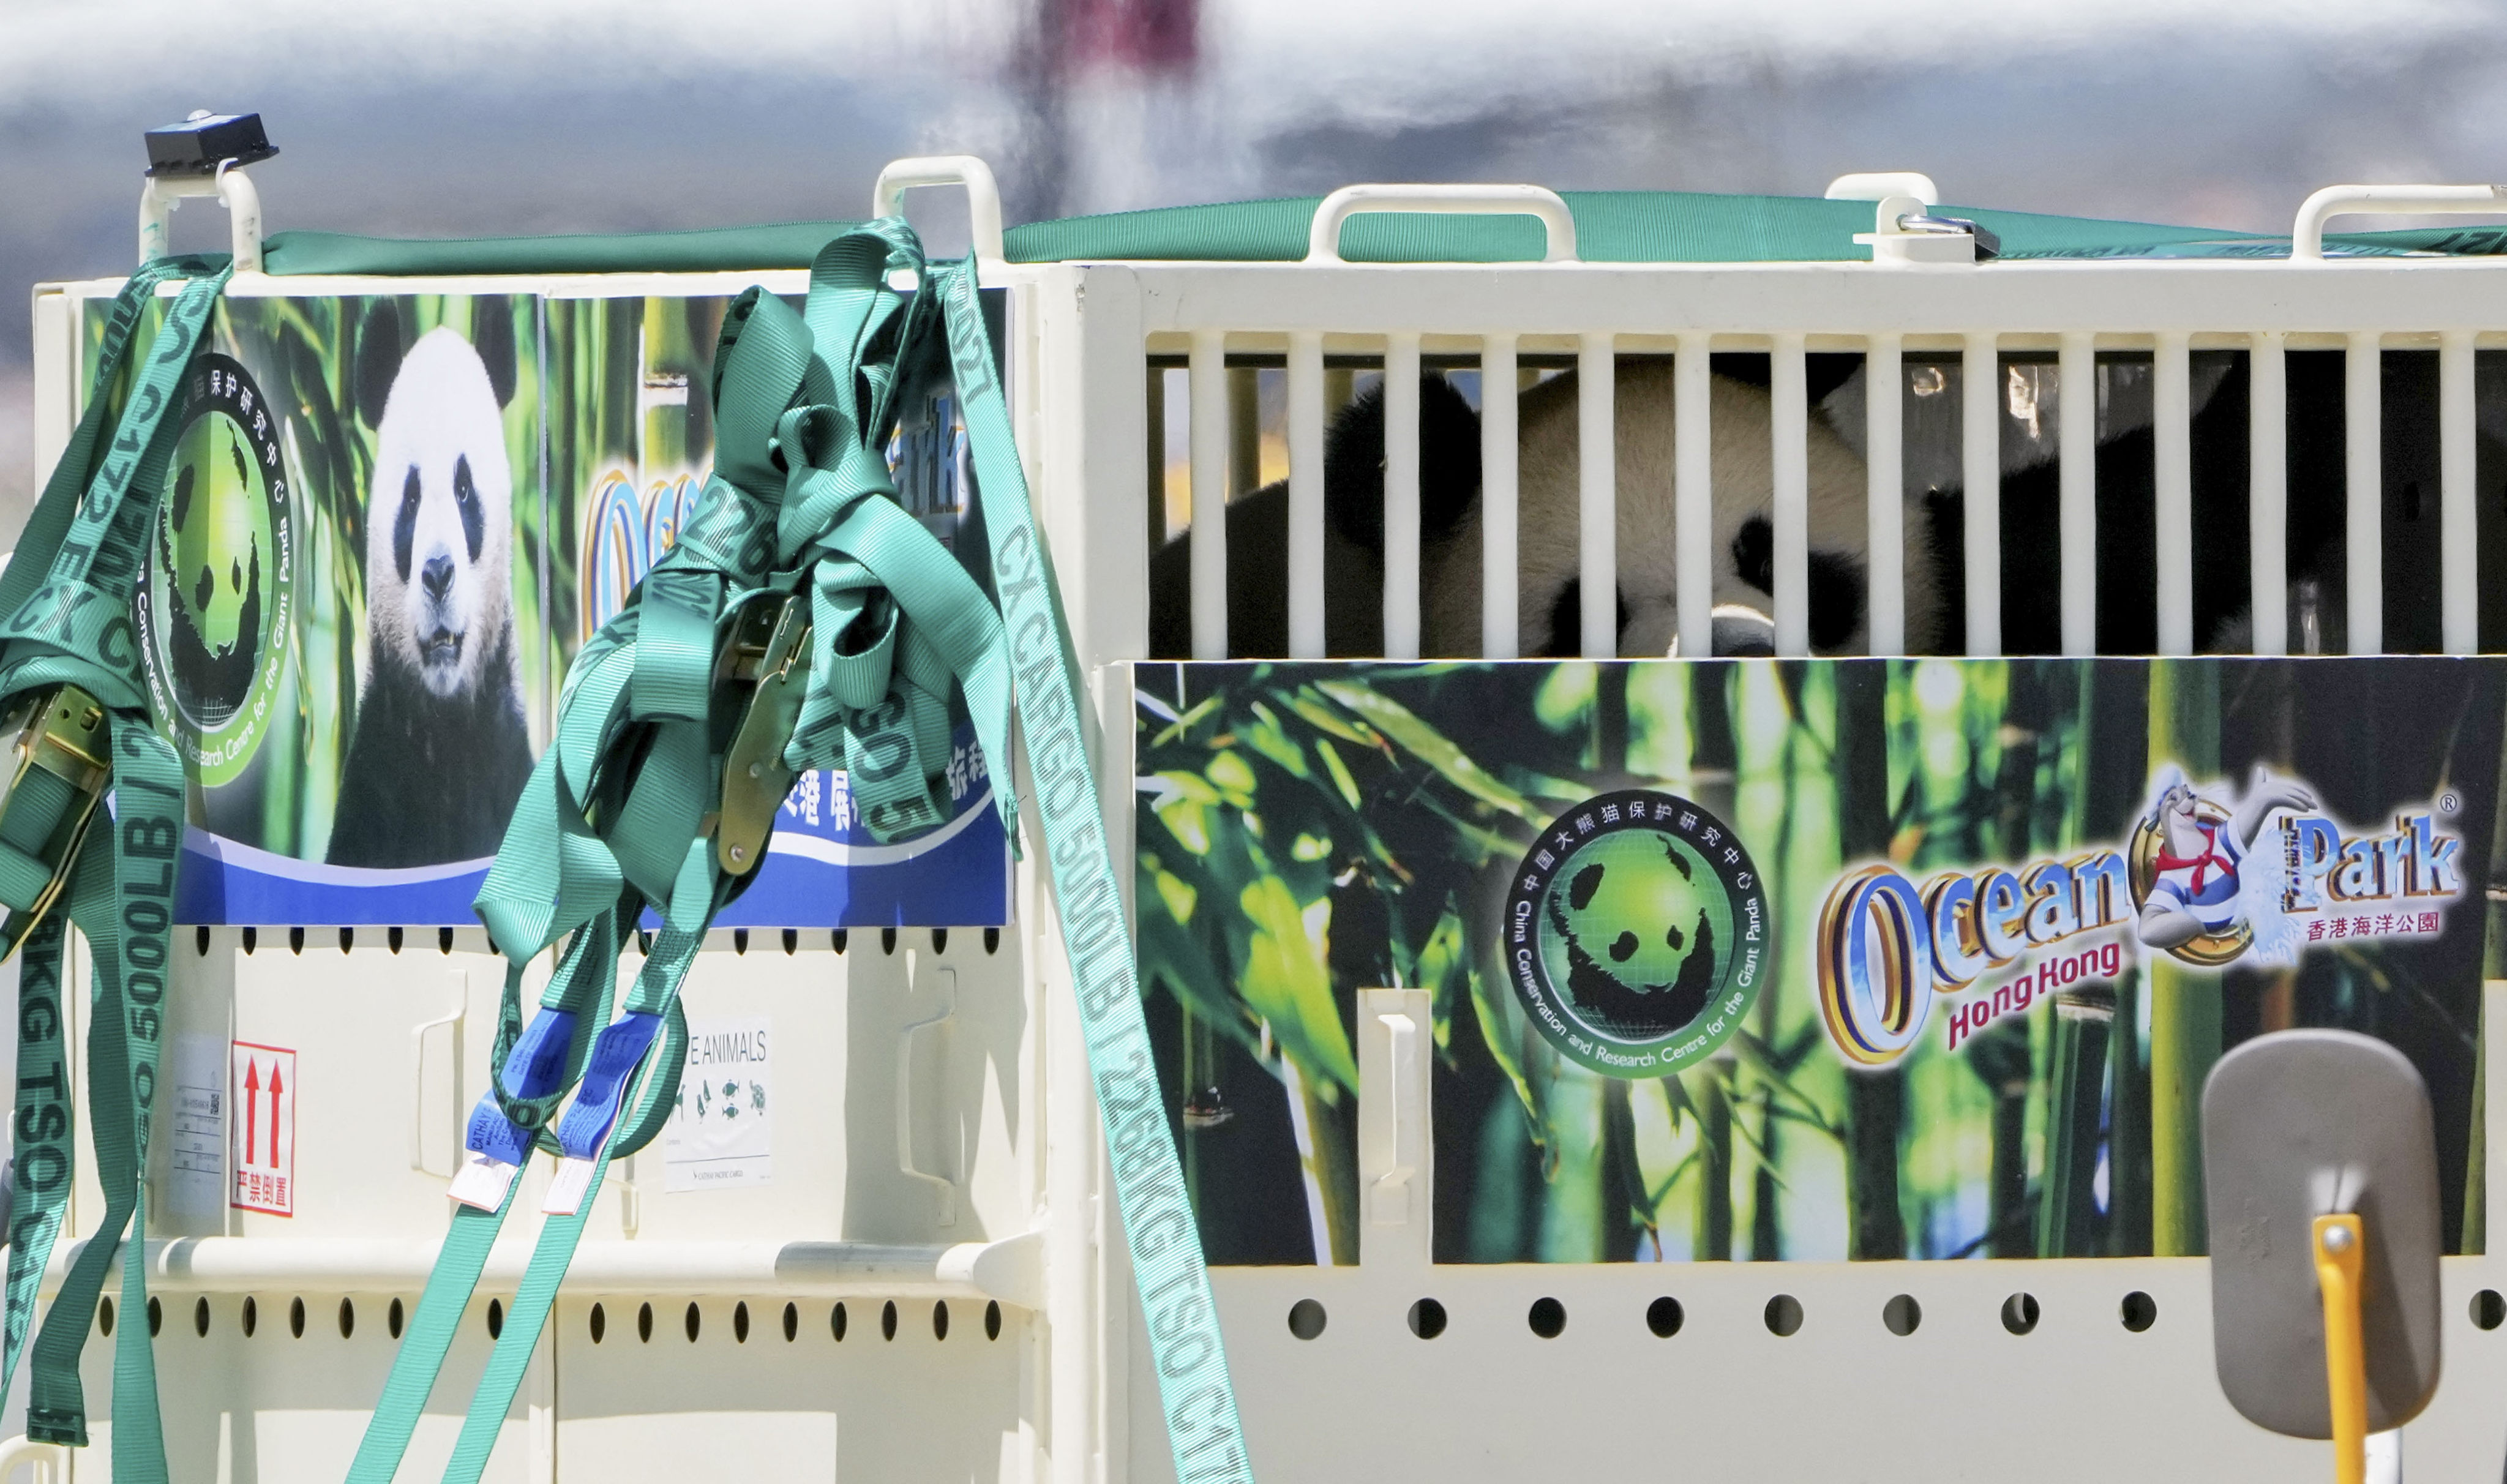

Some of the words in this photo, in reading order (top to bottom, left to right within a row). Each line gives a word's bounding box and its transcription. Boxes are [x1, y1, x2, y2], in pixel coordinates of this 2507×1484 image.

[280, 516, 289, 582] Panda
[997, 525, 1038, 613] CX
[274, 592, 288, 649] Giant
[138, 592, 168, 721] Conservation
[265, 657, 277, 690] the
[253, 692, 267, 722] for
[1015, 612, 1085, 820] CARGO
[168, 719, 183, 748] and
[186, 736, 223, 766] Research
[225, 721, 254, 760] Centre
[1523, 801, 1753, 893] 中国大熊猫保护研究中心
[124, 816, 177, 1043] 5000LB
[1056, 823, 1130, 1022] 5000LB
[1513, 900, 1532, 943] China
[1744, 897, 1760, 942] Panda
[1816, 850, 2131, 1065] Ocean
[2279, 814, 2460, 913] Park
[2307, 912, 2439, 942] 香港海洋公園
[1737, 947, 1760, 988] Giant
[1516, 948, 1567, 1036] Conservation
[1725, 991, 1744, 1017] the
[1949, 975, 2033, 1051] Hong
[2039, 943, 2120, 994] Kong
[1568, 1032, 1593, 1055] and
[1706, 1015, 1726, 1036] for
[702, 1030, 766, 1065] ANIMALS
[1595, 1045, 1657, 1066] Research
[1661, 1035, 1707, 1062] Centre
[18, 1062, 67, 1192] TSO
[471, 1112, 491, 1150] CATHAY
[559, 1119, 572, 1152] CATHAY
[1100, 1051, 1186, 1261] 2268KG
[236, 1169, 287, 1206] 严禁倒置
[1147, 1257, 1215, 1379] TSO
[1172, 1385, 1243, 1484] C17
